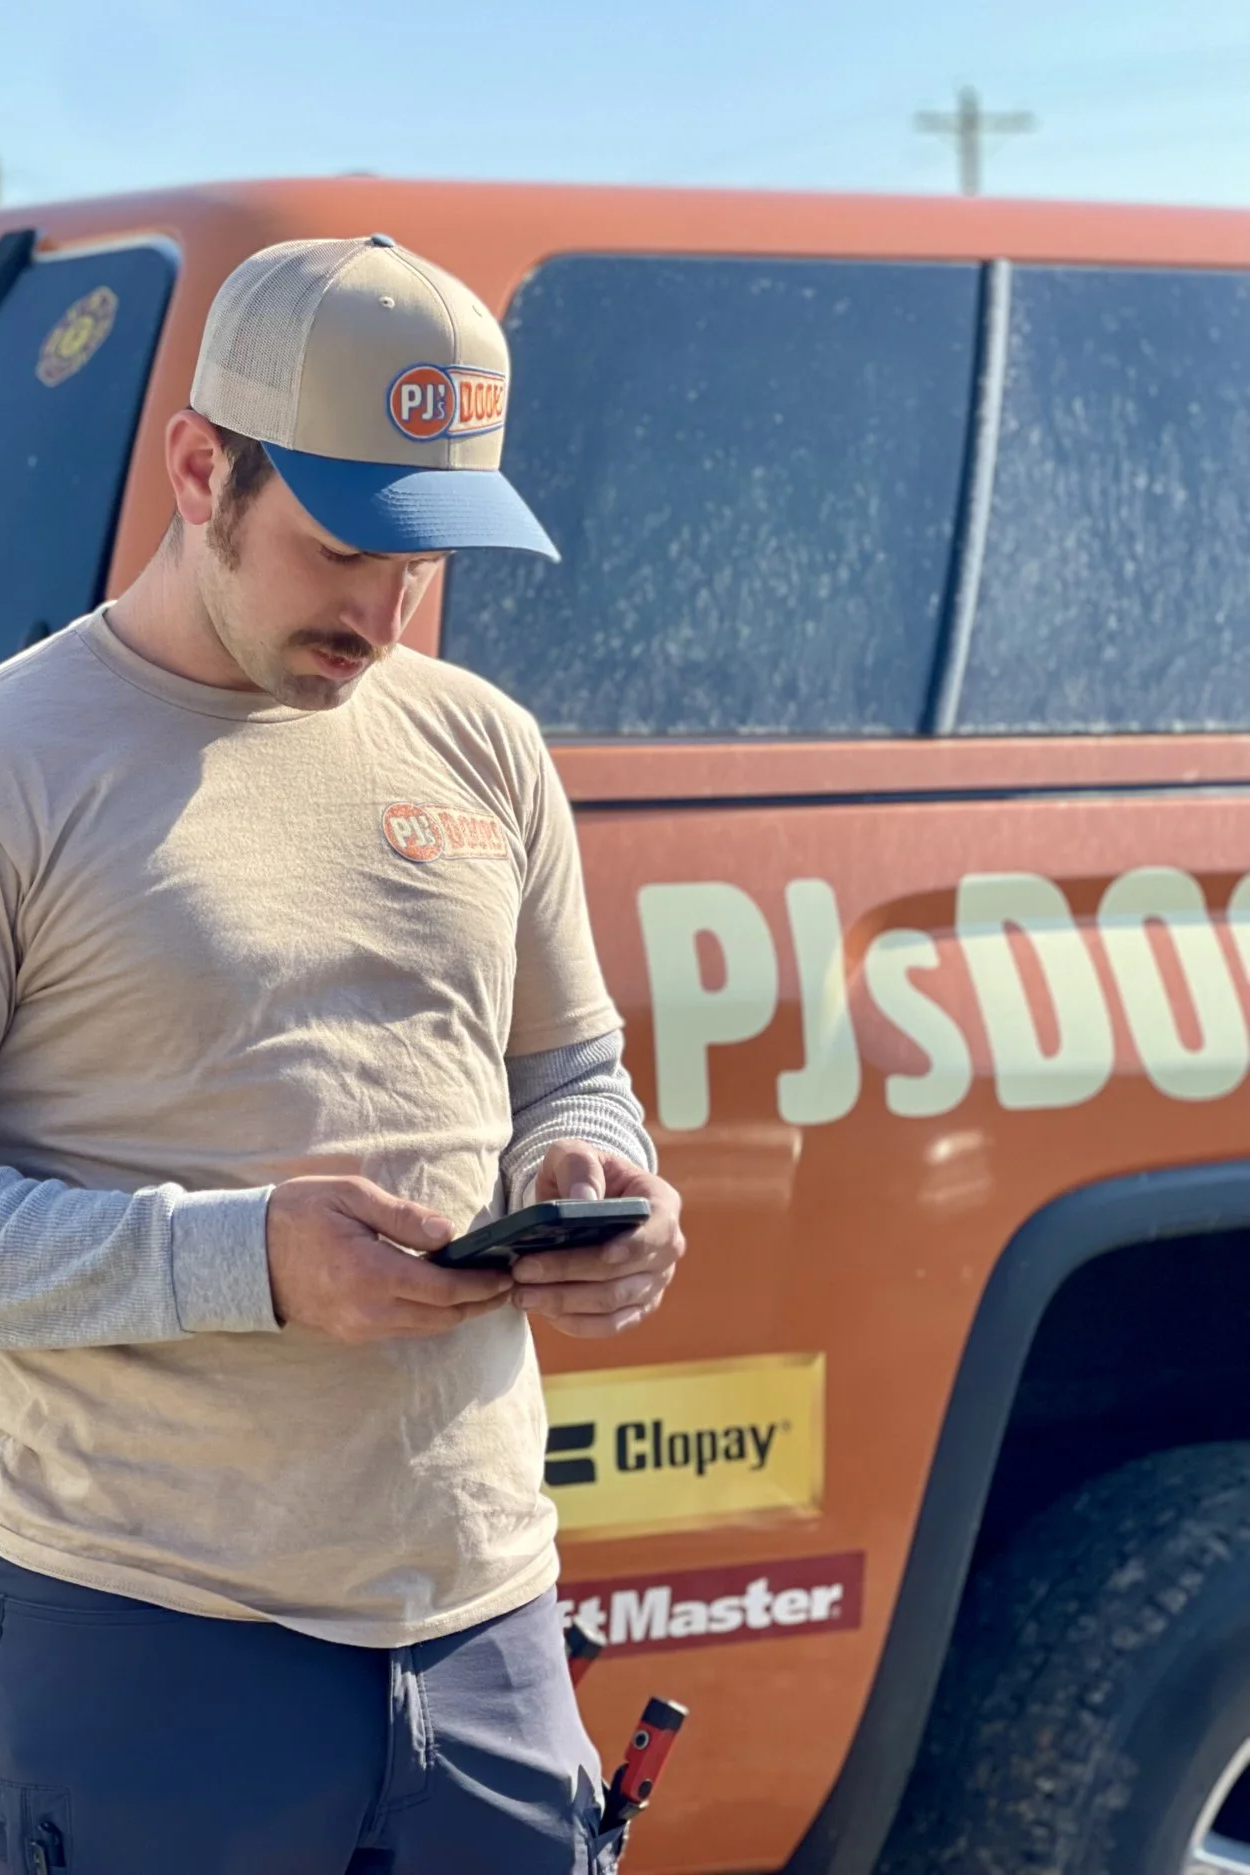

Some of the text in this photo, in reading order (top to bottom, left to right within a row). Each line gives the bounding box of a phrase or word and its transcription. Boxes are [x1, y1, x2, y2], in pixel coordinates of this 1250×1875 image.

[400, 383, 446, 421] PJ's
[637, 866, 1250, 1130] PJsDO
[615, 1418, 777, 1476] Clopay
